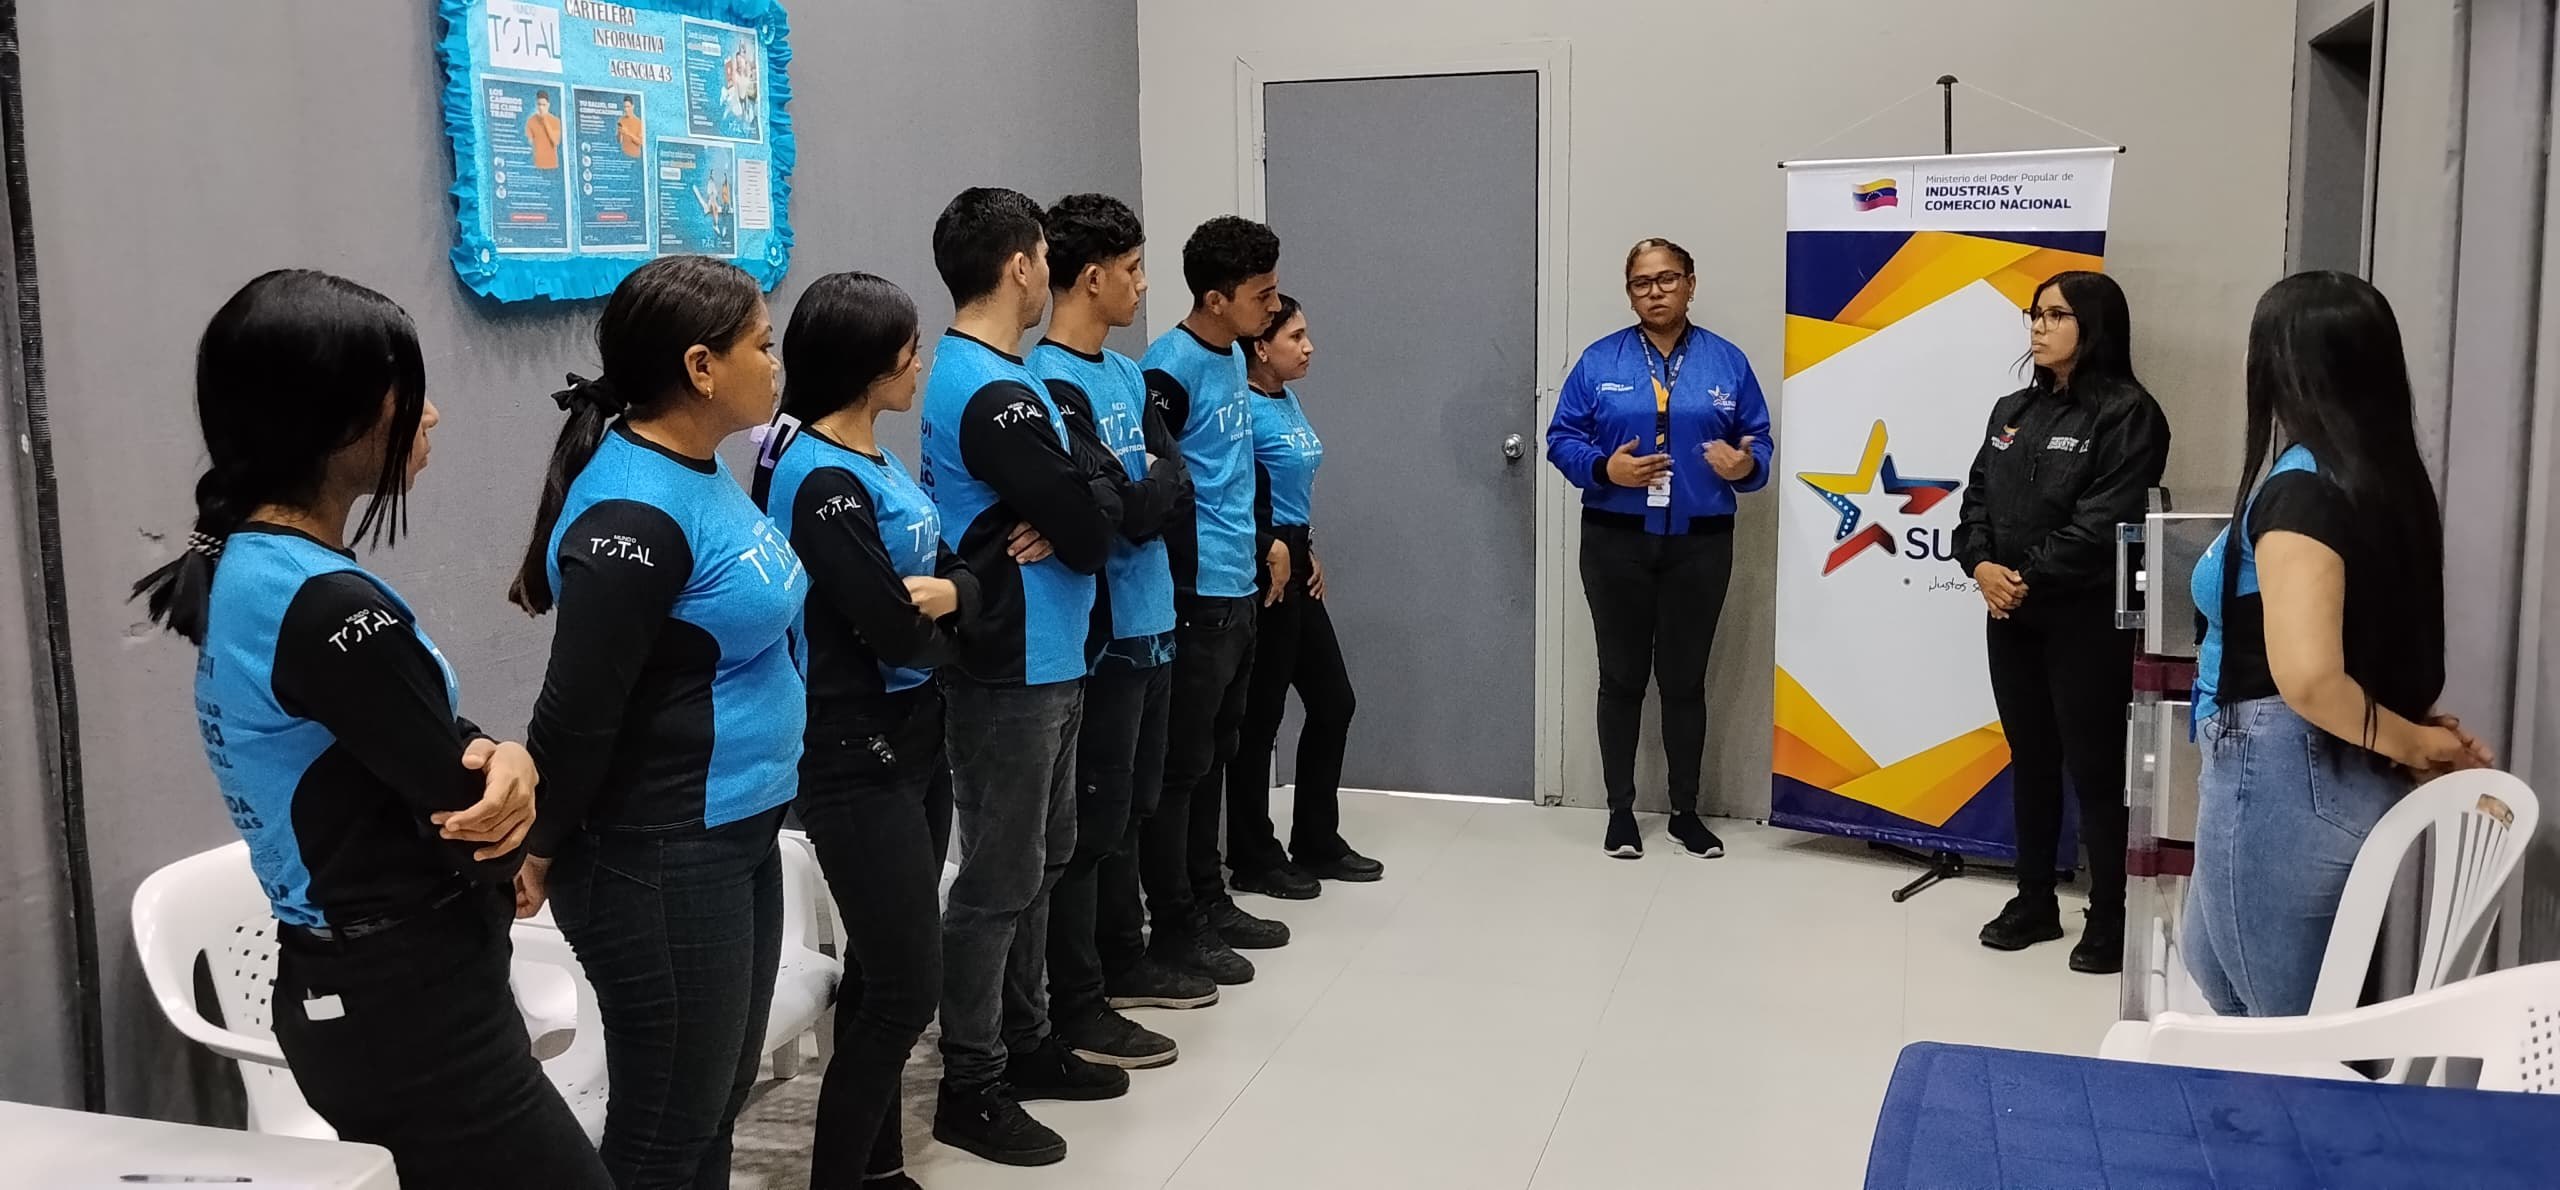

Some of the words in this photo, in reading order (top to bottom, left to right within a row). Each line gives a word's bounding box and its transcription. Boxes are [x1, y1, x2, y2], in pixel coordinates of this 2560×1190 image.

[565, 0, 635, 25] CARTELERA
[488, 14, 561, 59] TOTAL
[593, 28, 664, 53] INFORMATIVA
[610, 61, 655, 80] AGENCIA
[658, 66, 672, 81] 43
[1925, 185, 2010, 197] INDUSTRIAS
[2014, 184, 2023, 195] Y
[1926, 174, 1971, 183] Ministerio
[1973, 174, 1987, 182] del
[1990, 174, 2018, 182] Poder
[2021, 173, 2059, 184] Popular
[2061, 172, 2074, 181] de
[1924, 200, 1996, 211] COMERCIO
[1999, 198, 2072, 210] NACIONAL
[993, 404, 1043, 429] TOTAL
[815, 495, 862, 521] TOTAL
[590, 537, 655, 567] TOTAL
[1928, 575, 1967, 593] Justos
[328, 609, 399, 653] TOTAL
